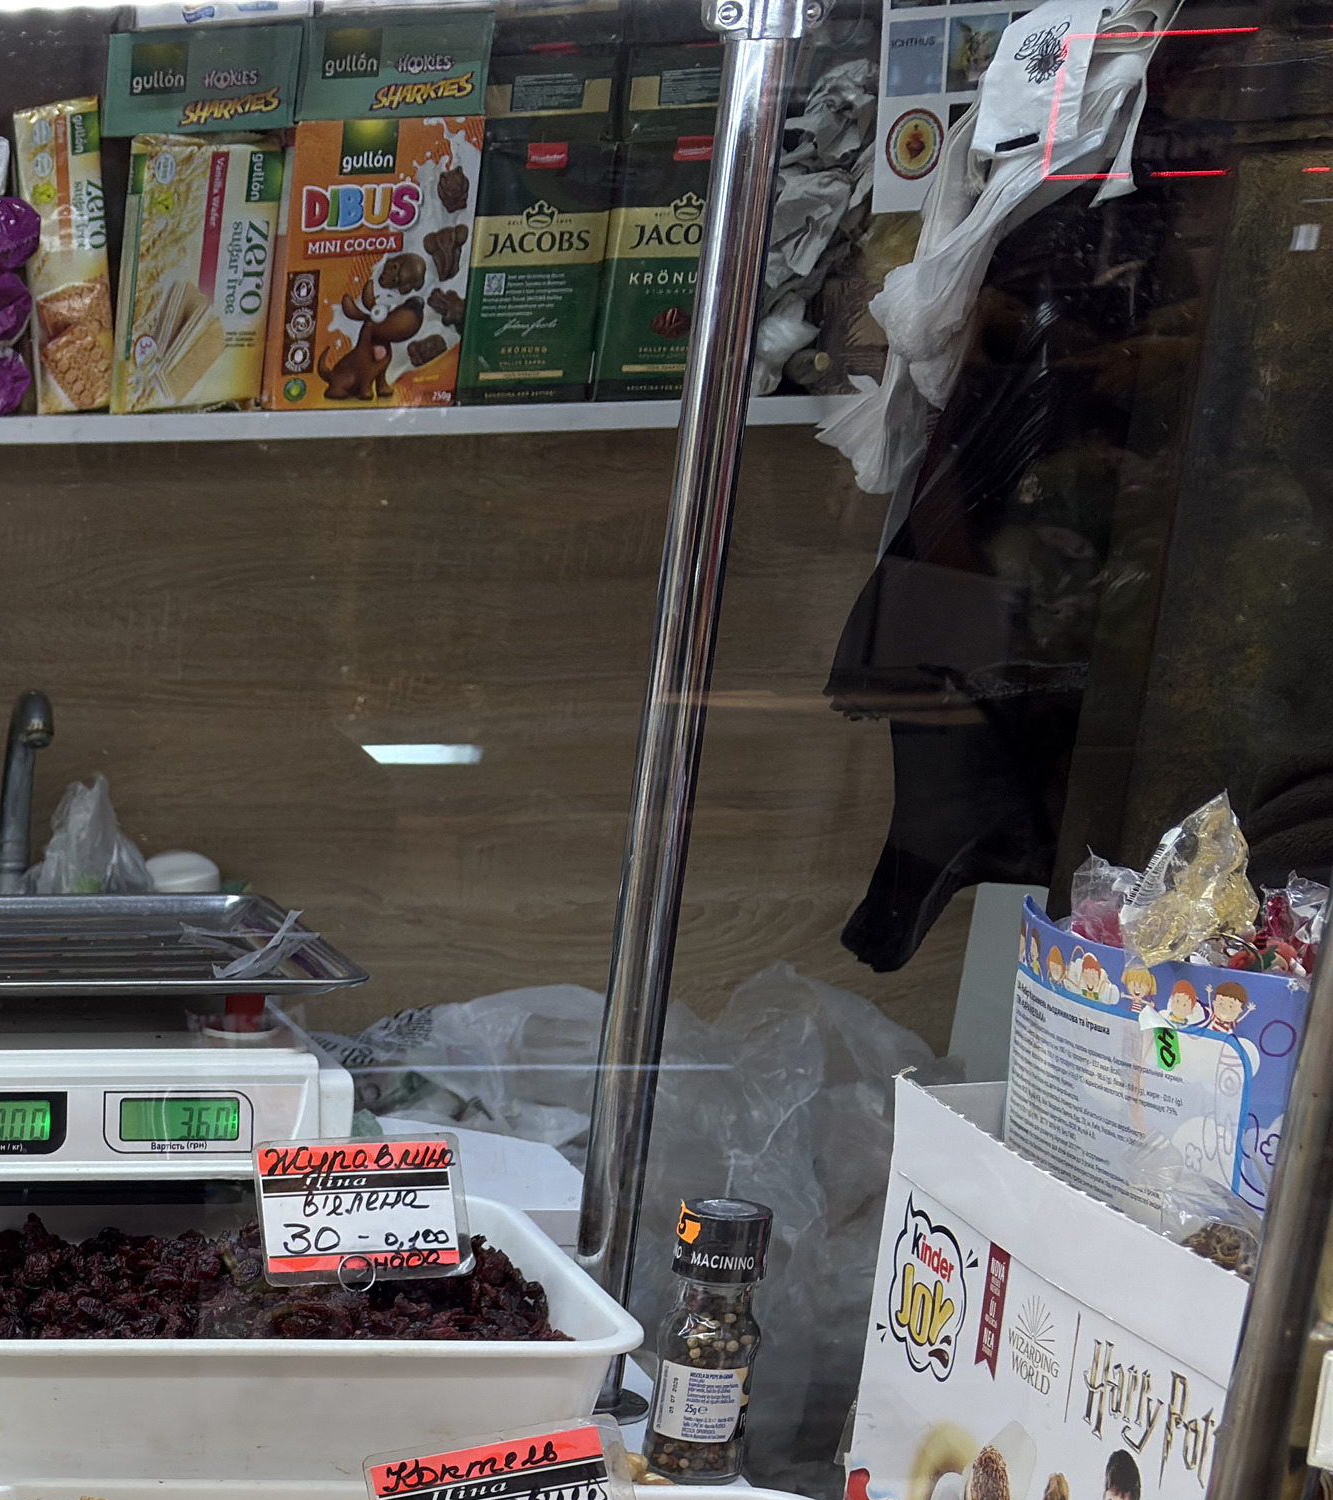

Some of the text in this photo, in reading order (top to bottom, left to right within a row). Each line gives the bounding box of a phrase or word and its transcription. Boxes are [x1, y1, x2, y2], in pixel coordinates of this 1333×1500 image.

[132, 70, 185, 93] gullón
[325, 52, 379, 77] gullón
[179, 88, 280, 127] SHARKIES
[373, 71, 474, 110] SHARKIES
[249, 152, 265, 202] gullón
[341, 149, 394, 173] gullón
[303, 184, 422, 231] DIBUS
[306, 235, 397, 255] MINI COCOA
[485, 230, 591, 259] JACOBS
[628, 223, 703, 249] JACO
[223, 221, 245, 315] sugar free
[239, 220, 271, 316] zero
[150, 1141, 208, 1151] Вартість (грн)
[282, 1222, 341, 1254] 30
[911, 1222, 955, 1283] Kinder
[690, 1251, 755, 1272] MACININO
[991, 1257, 1006, 1282] NOVÁ
[895, 1262, 955, 1348] JOY
[1009, 1327, 1060, 1378] WIZARDING
[1012, 1350, 1050, 1396] WORLD
[1082, 1338, 1215, 1490] Harry Pot
